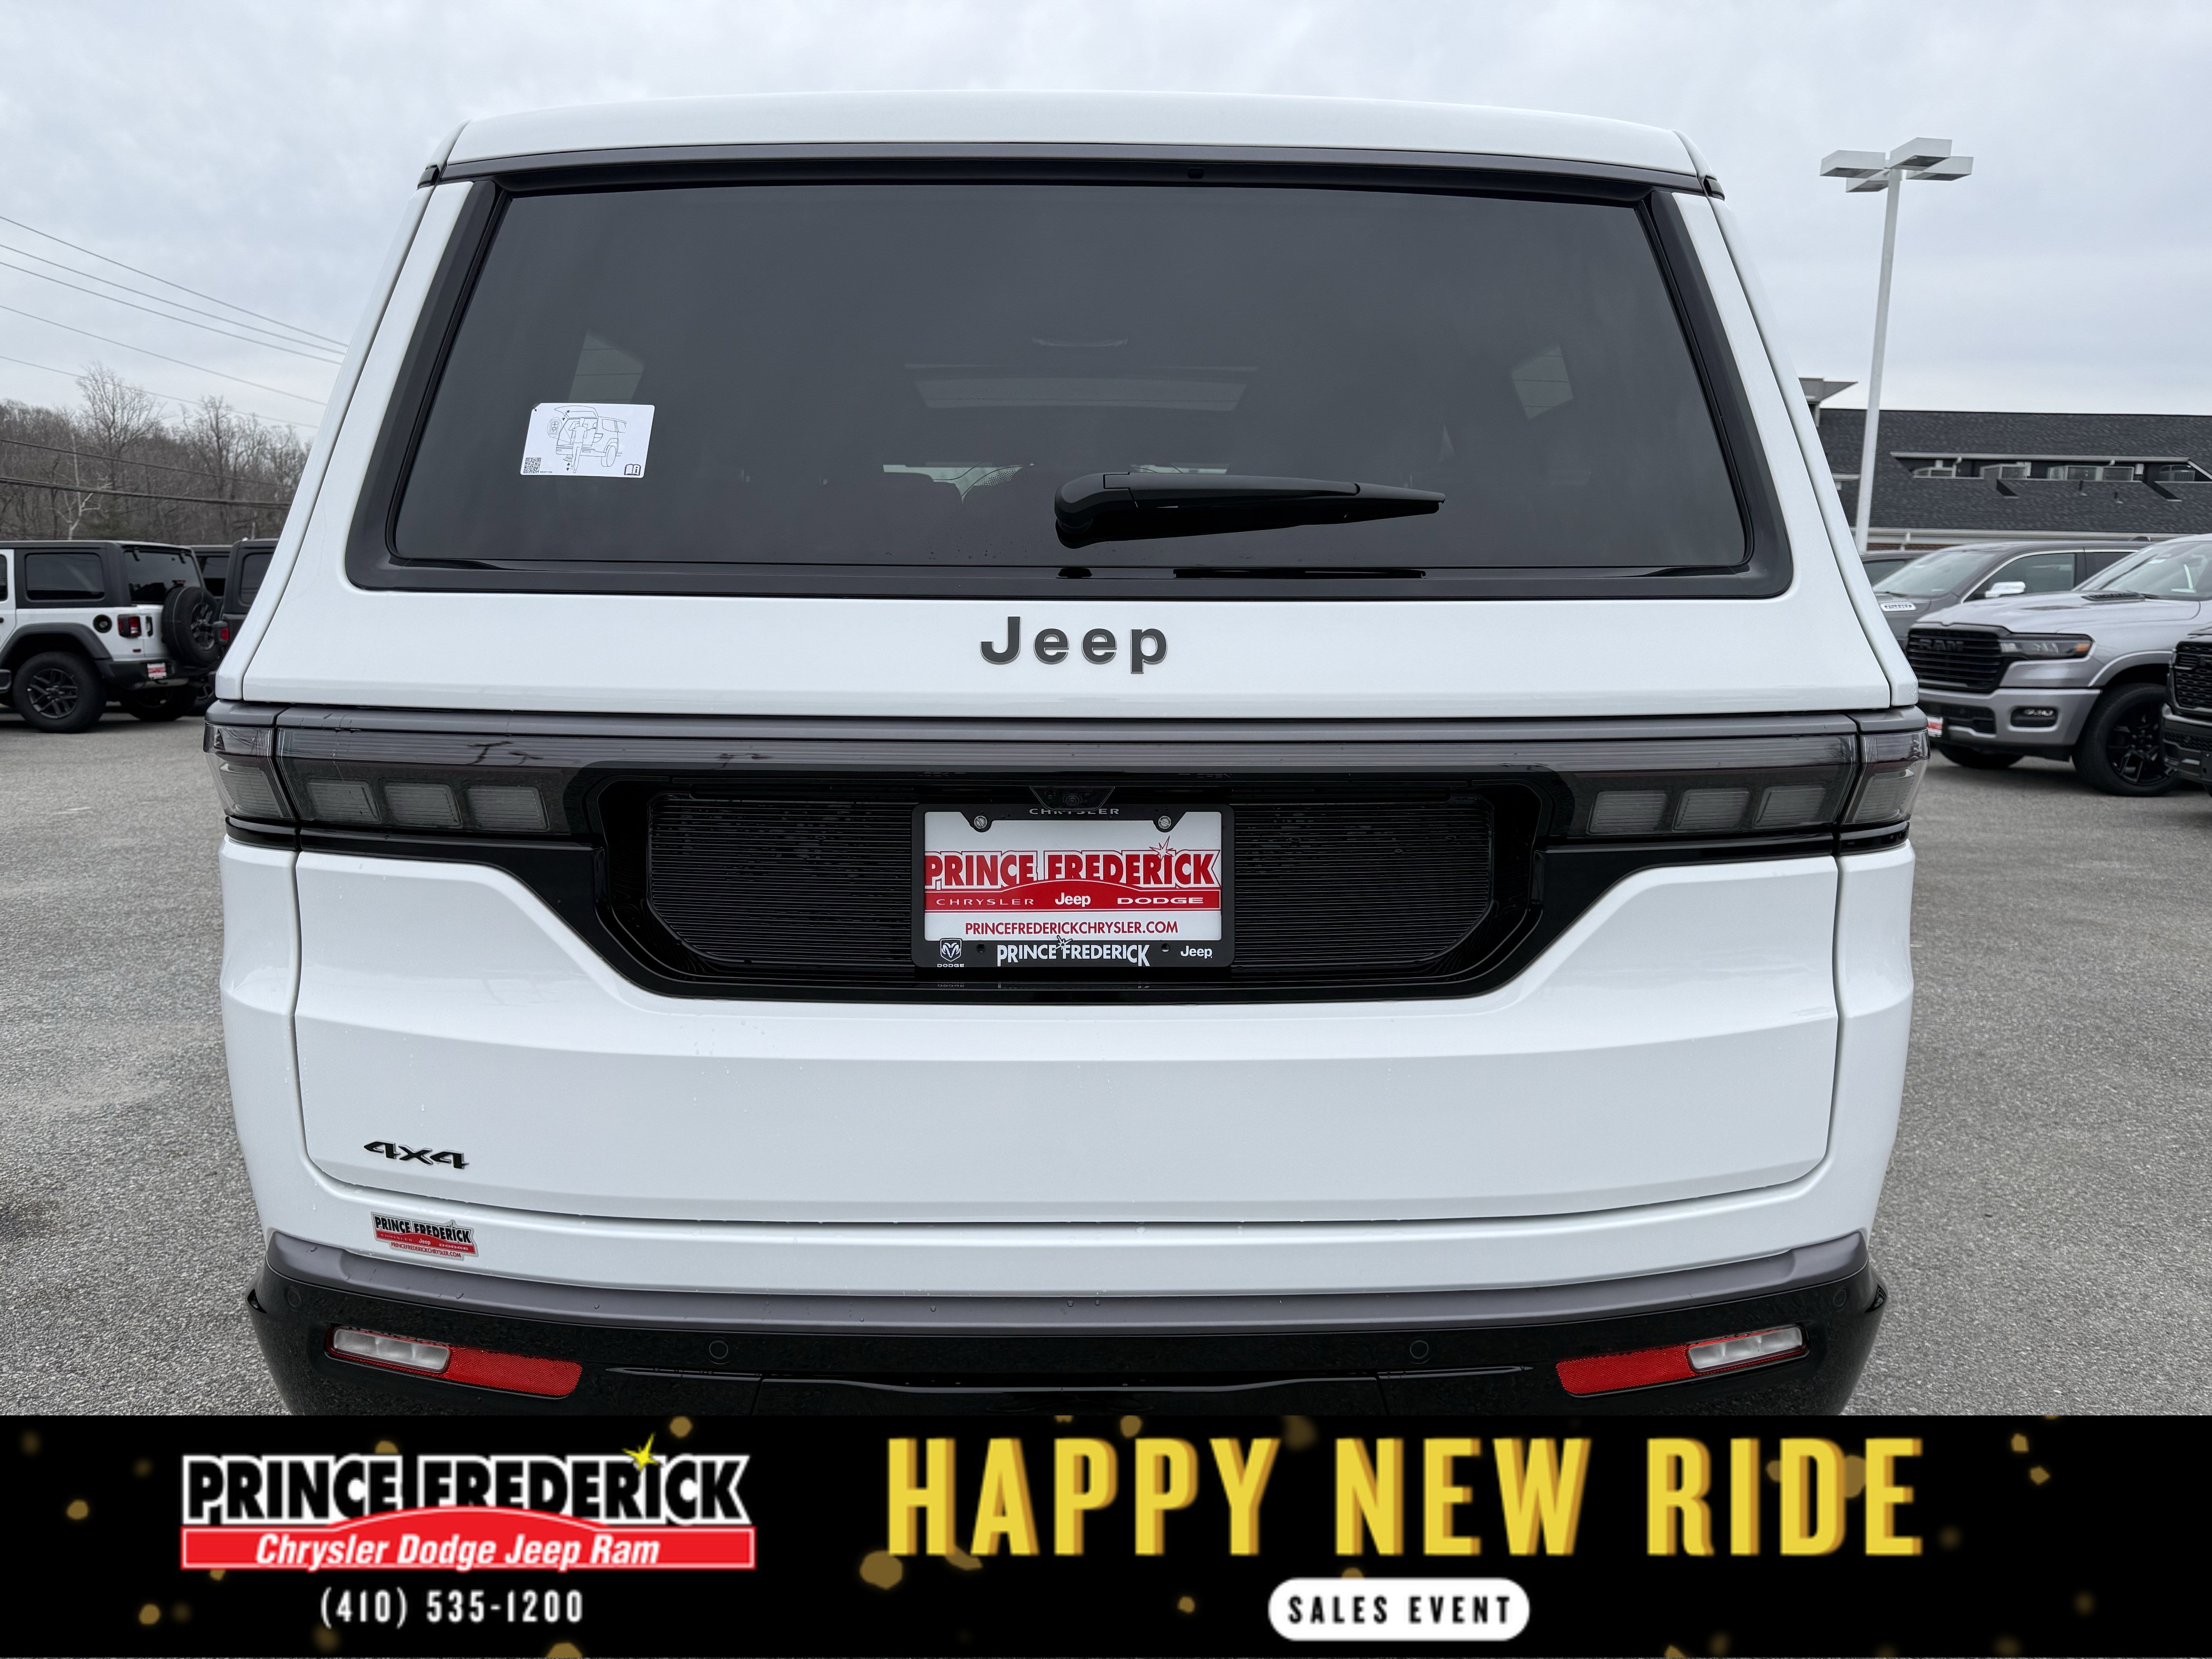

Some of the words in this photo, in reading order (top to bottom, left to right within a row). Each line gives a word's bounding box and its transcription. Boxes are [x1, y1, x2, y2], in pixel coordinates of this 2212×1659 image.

[980, 616, 1168, 674] Jeep
[925, 854, 1037, 886] PRINCE
[1054, 854, 1214, 886] FREDERICK
[1054, 892, 1091, 907] Jeep
[965, 921, 1178, 935] PRINCEFREDERICKCHRYSLER.COM
[997, 945, 1056, 967] PRINCE
[1062, 945, 1150, 967] FREDERICK
[1180, 945, 1212, 958] Jeep
[364, 1141, 469, 1170] 4x4
[375, 1216, 411, 1233] PRINCE
[414, 1222, 471, 1244] FREDERICK
[391, 1242, 462, 1258] PRINCEFREDERICKCHRYSLER.COM
